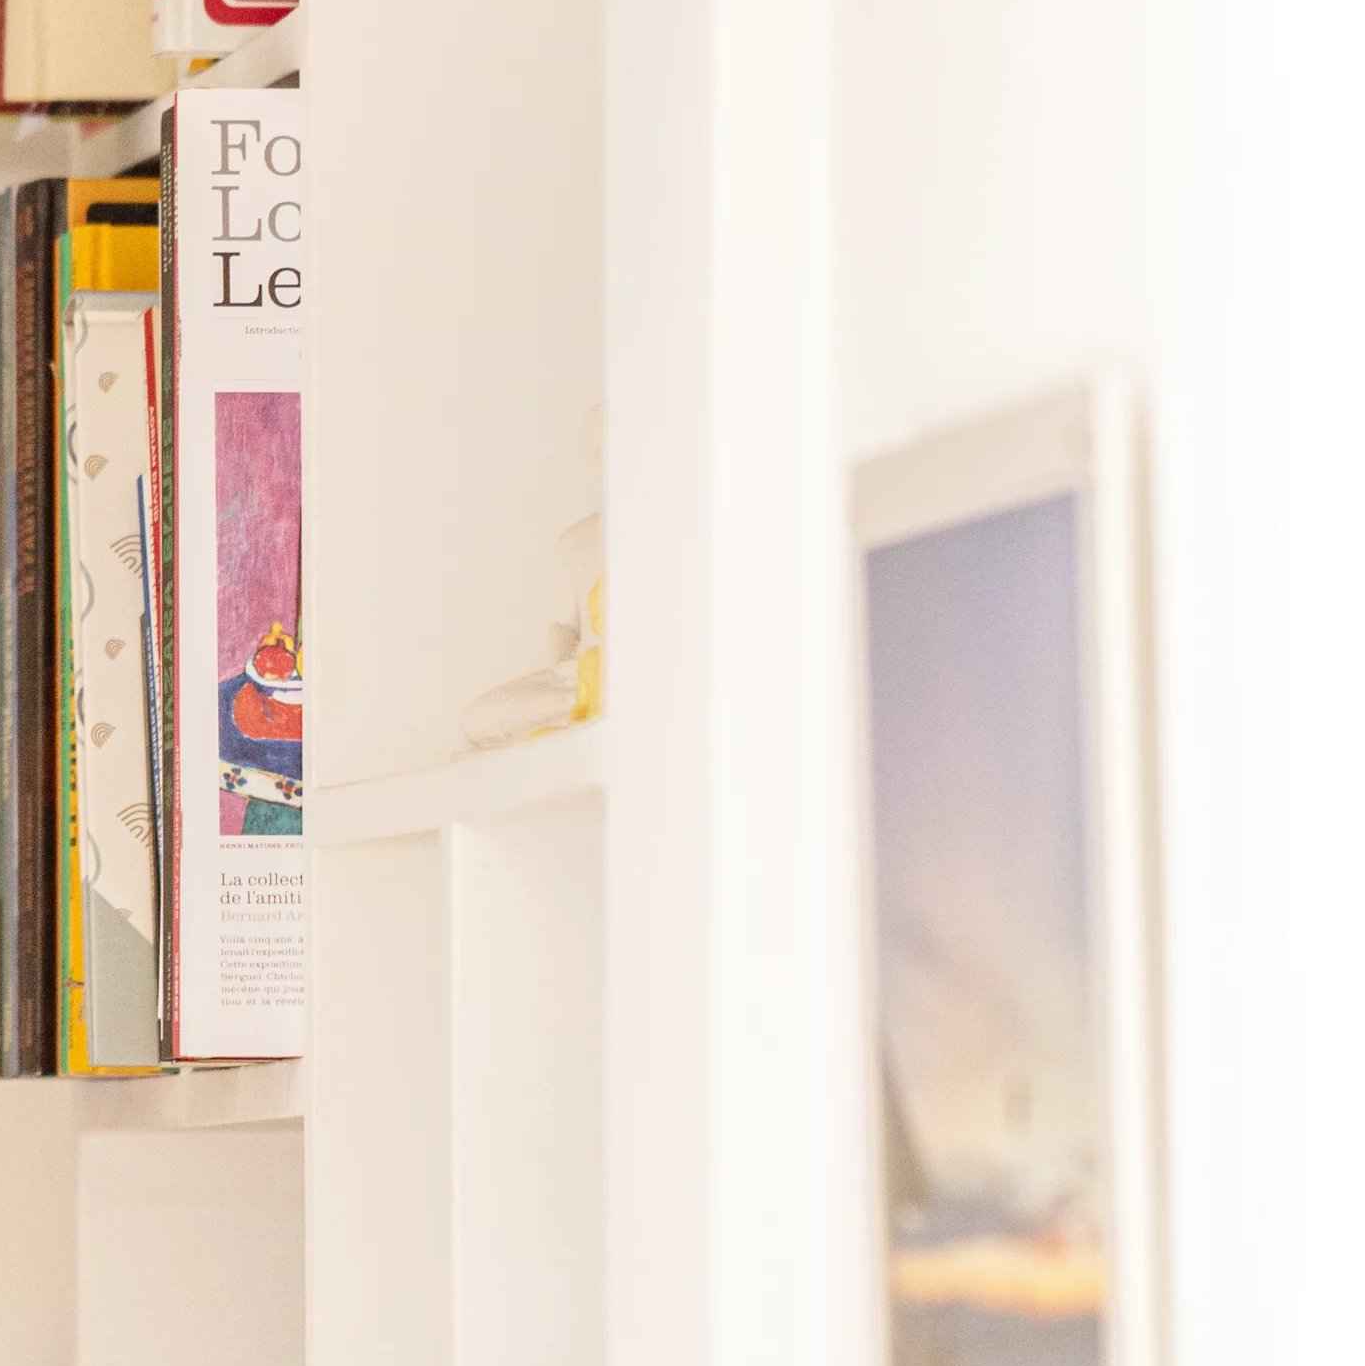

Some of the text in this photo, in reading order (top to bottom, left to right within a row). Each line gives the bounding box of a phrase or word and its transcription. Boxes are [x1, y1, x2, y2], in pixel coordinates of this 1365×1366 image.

[211, 120, 301, 176] Fo
[213, 252, 301, 308] Le
[221, 872, 303, 886] La collect
[220, 891, 301, 904] de l'amiti
